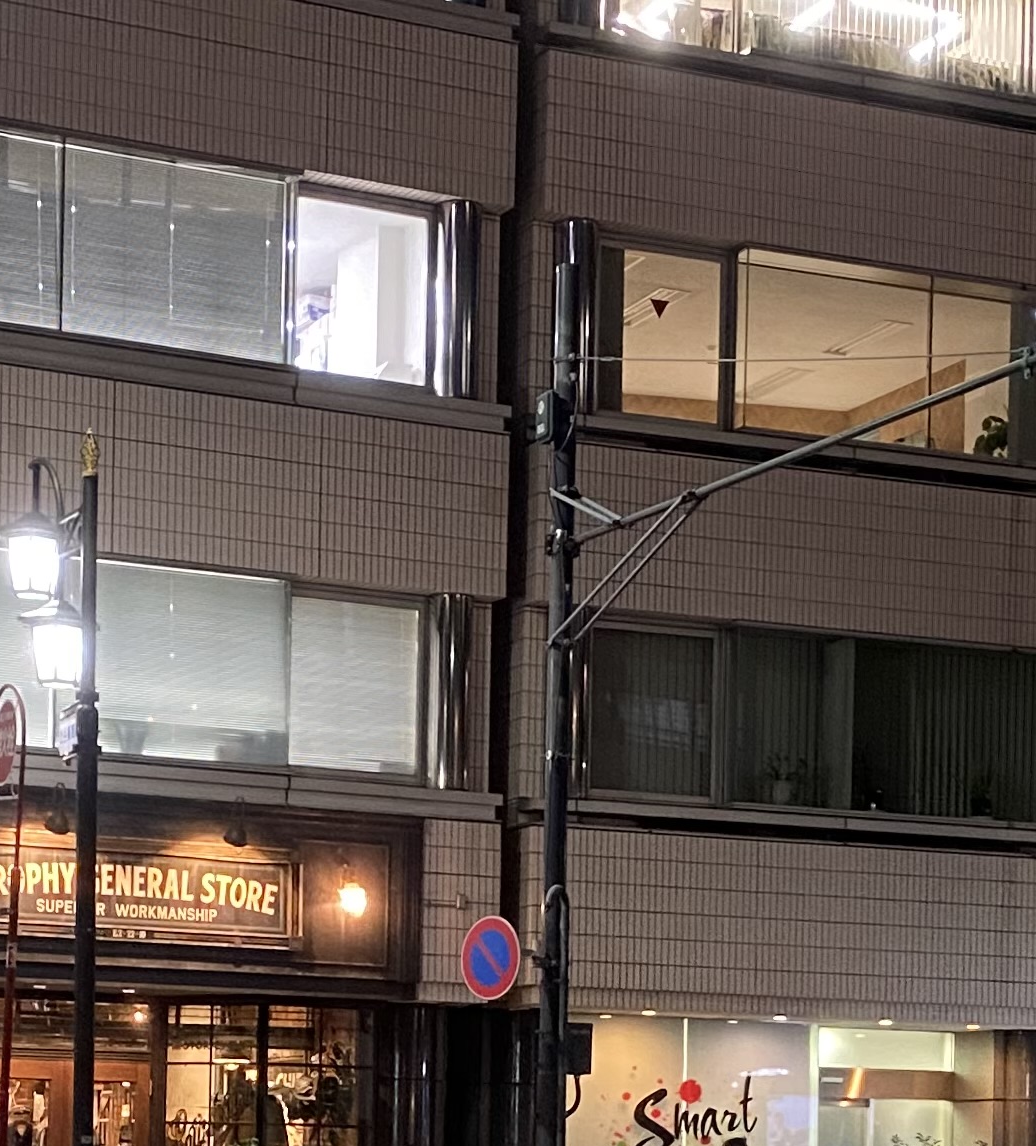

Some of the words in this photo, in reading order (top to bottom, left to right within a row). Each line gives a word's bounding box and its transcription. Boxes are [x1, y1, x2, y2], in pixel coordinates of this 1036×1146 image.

[95, 864, 195, 902] ENERAL
[200, 872, 279, 916] STORE
[115, 903, 218, 923] WORKMANSHIP
